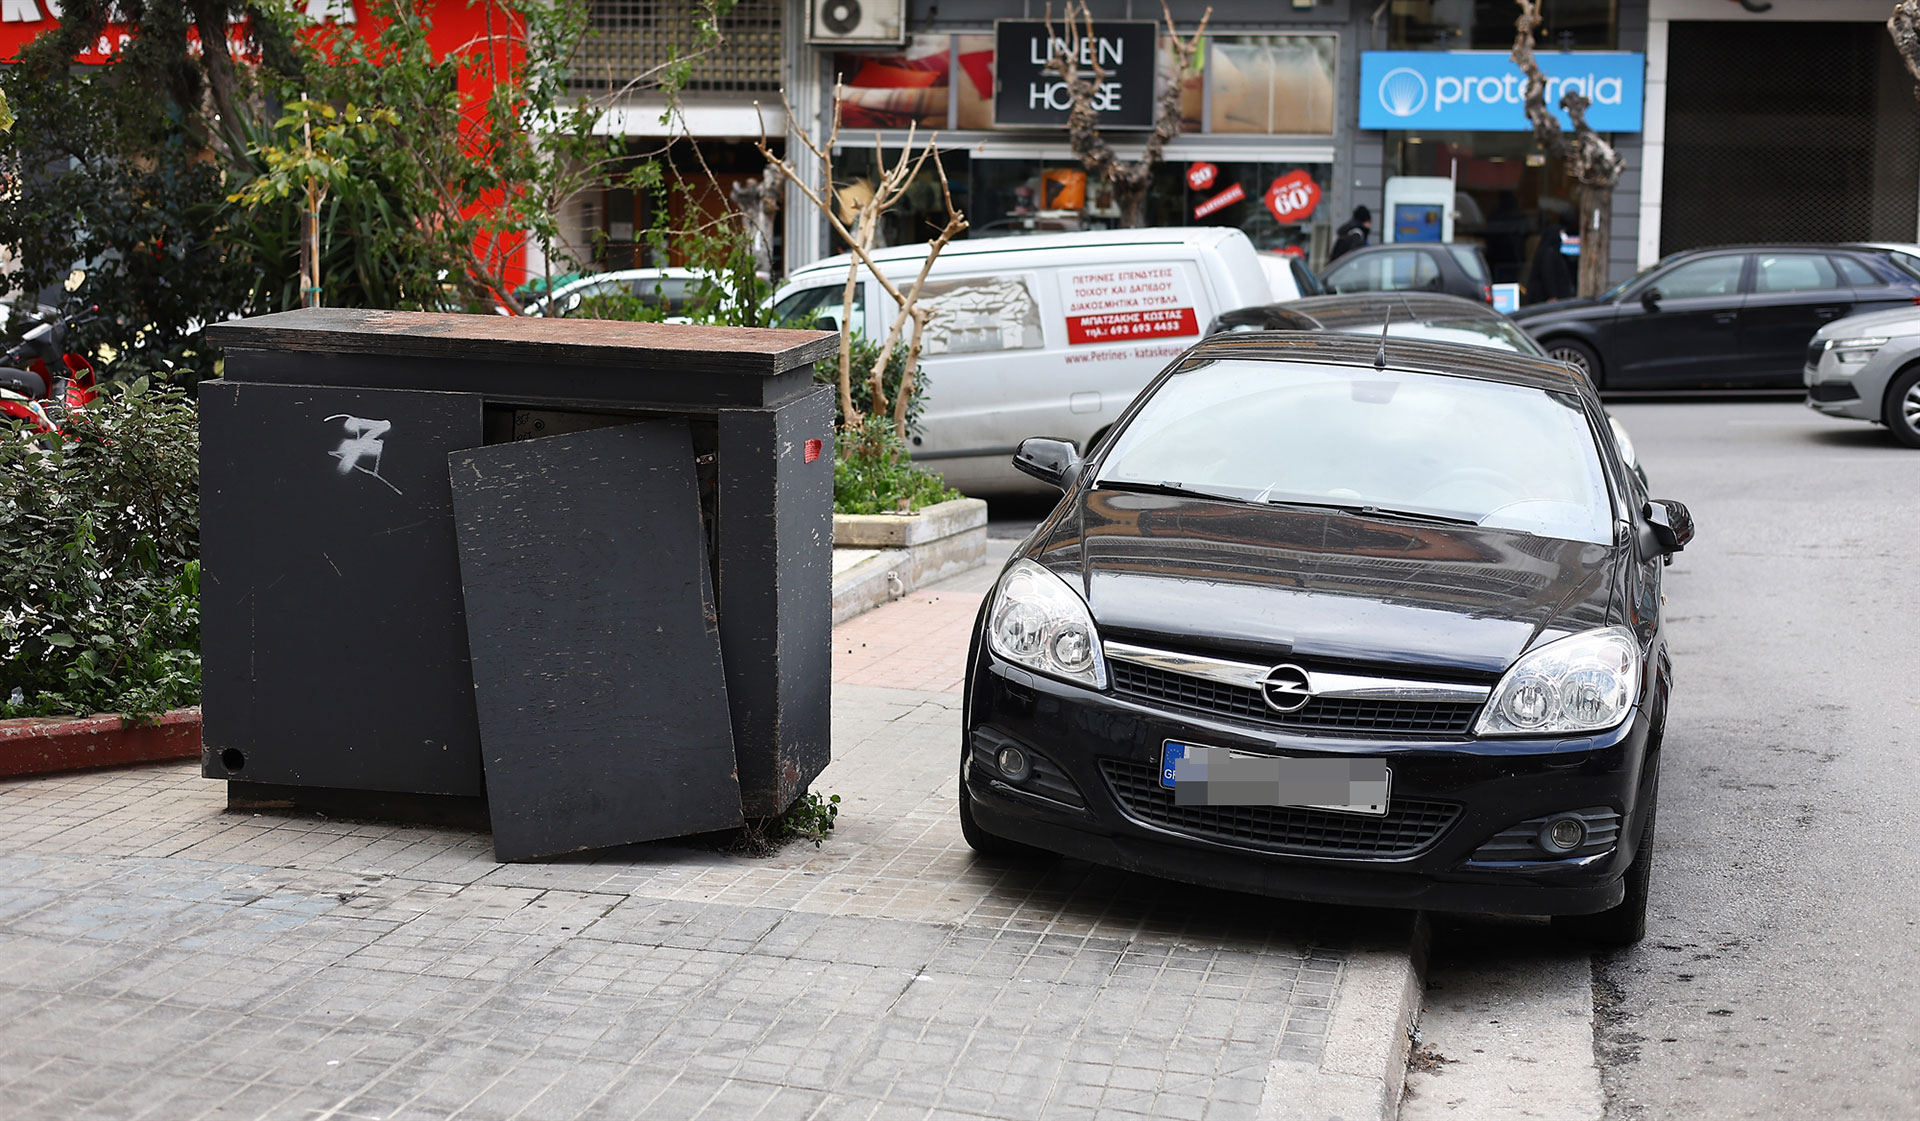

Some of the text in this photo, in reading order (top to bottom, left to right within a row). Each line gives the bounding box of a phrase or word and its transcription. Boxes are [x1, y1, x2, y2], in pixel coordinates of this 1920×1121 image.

[1031, 37, 1123, 65] LINEN
[1029, 82, 1122, 111] HOSE
[1072, 268, 1173, 285] ΠΕΤΡΙΝΕΣ ΕΠΕΝΔΥΣΕΙΣ
[1075, 282, 1172, 298] ΤΟΙΧΟΥ ΚΑΙ ΔΑΠΕΔΟΥ
[1070, 295, 1178, 312] ΔΙΑΚΟΣΜΗΤΙΚΑ ΤΟΥΒΛΑ
[1080, 309, 1183, 327] ΜΠΑΤΖΑΚΗΣ ΚΩΣΤΑΣ
[1085, 320, 1180, 338] τηλ.: 693 693 4453
[1064, 350, 1127, 365] www.Petrines
